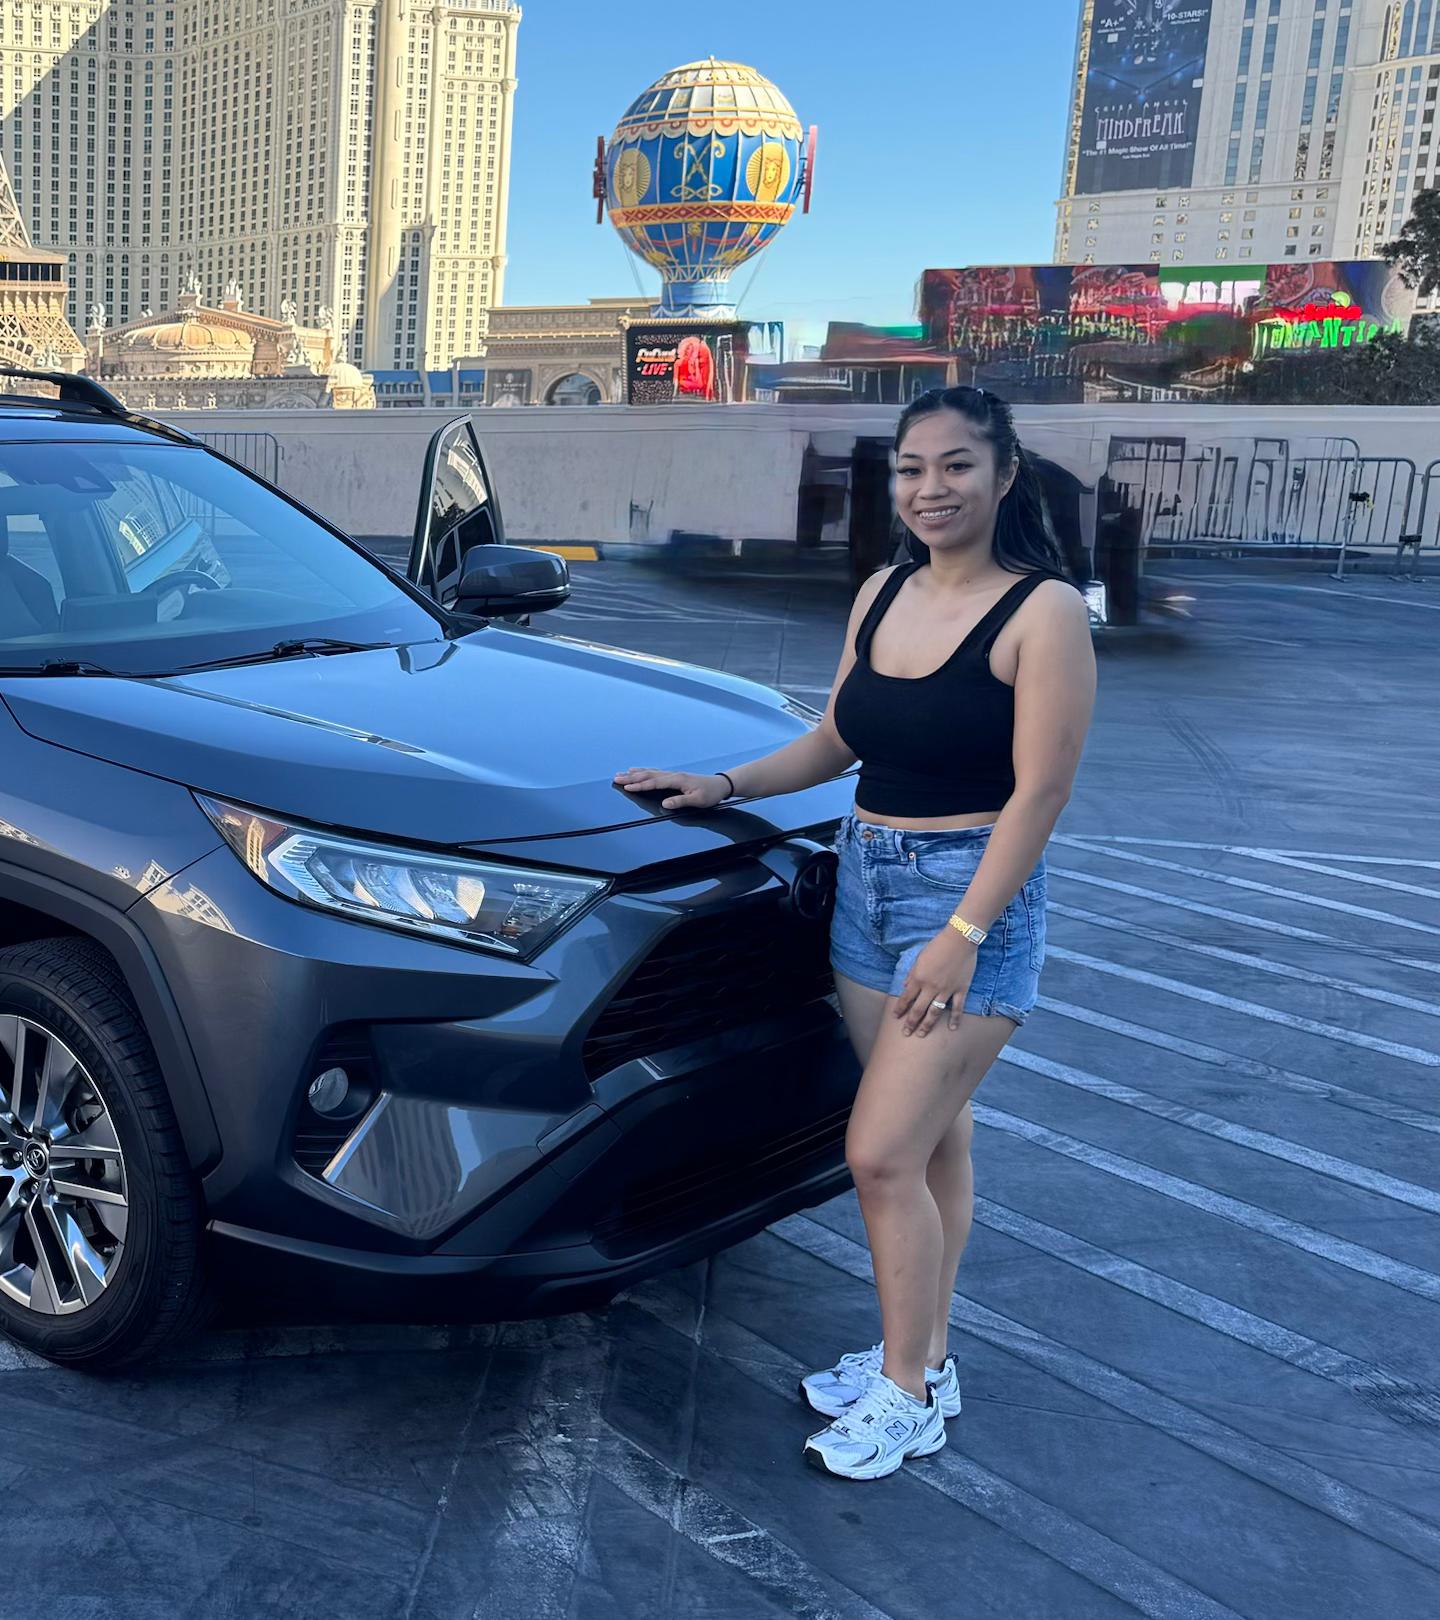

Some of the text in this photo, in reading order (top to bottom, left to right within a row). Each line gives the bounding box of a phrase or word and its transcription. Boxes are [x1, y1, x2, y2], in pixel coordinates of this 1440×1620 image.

[1143, 98, 1188, 108] ANGEL
[1096, 112, 1184, 141] MINDFREAK
[641, 363, 669, 376] LIVE
